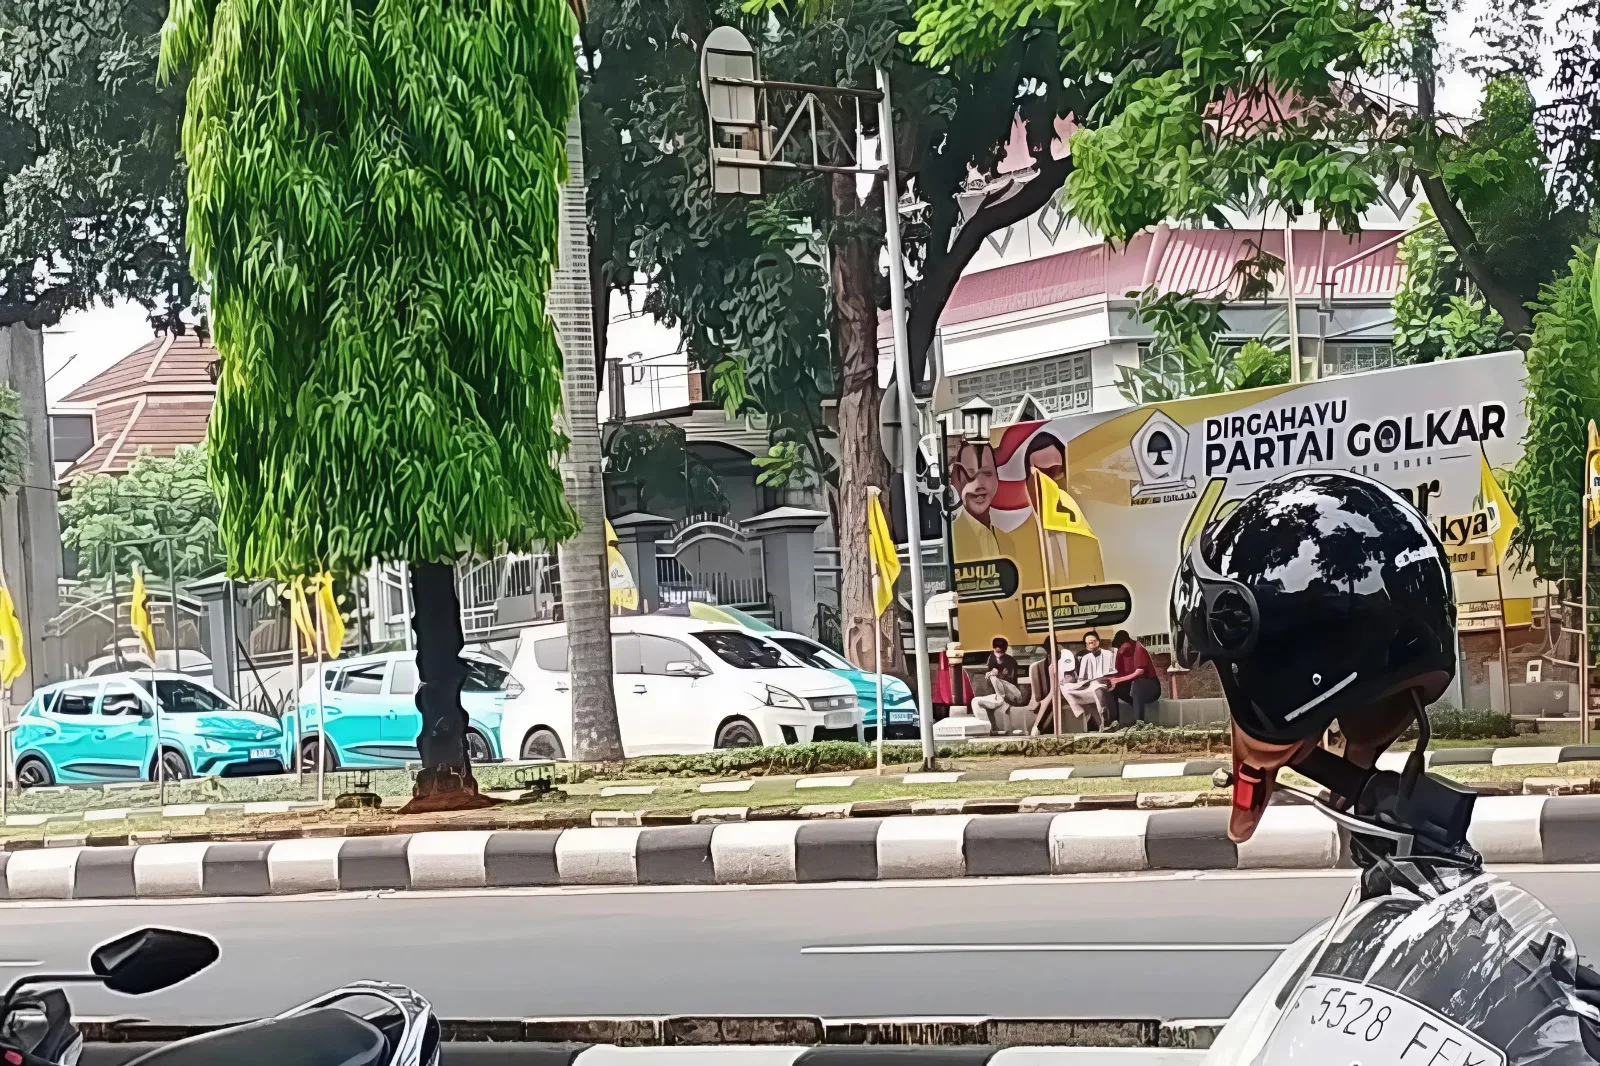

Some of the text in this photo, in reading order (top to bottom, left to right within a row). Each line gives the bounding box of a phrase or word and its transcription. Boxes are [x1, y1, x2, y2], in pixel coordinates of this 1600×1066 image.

[1205, 404, 1506, 476] PARTAI GOLKAR
[1206, 400, 1347, 441] DIRGAHAYU
[1311, 987, 1392, 1042] 5528
